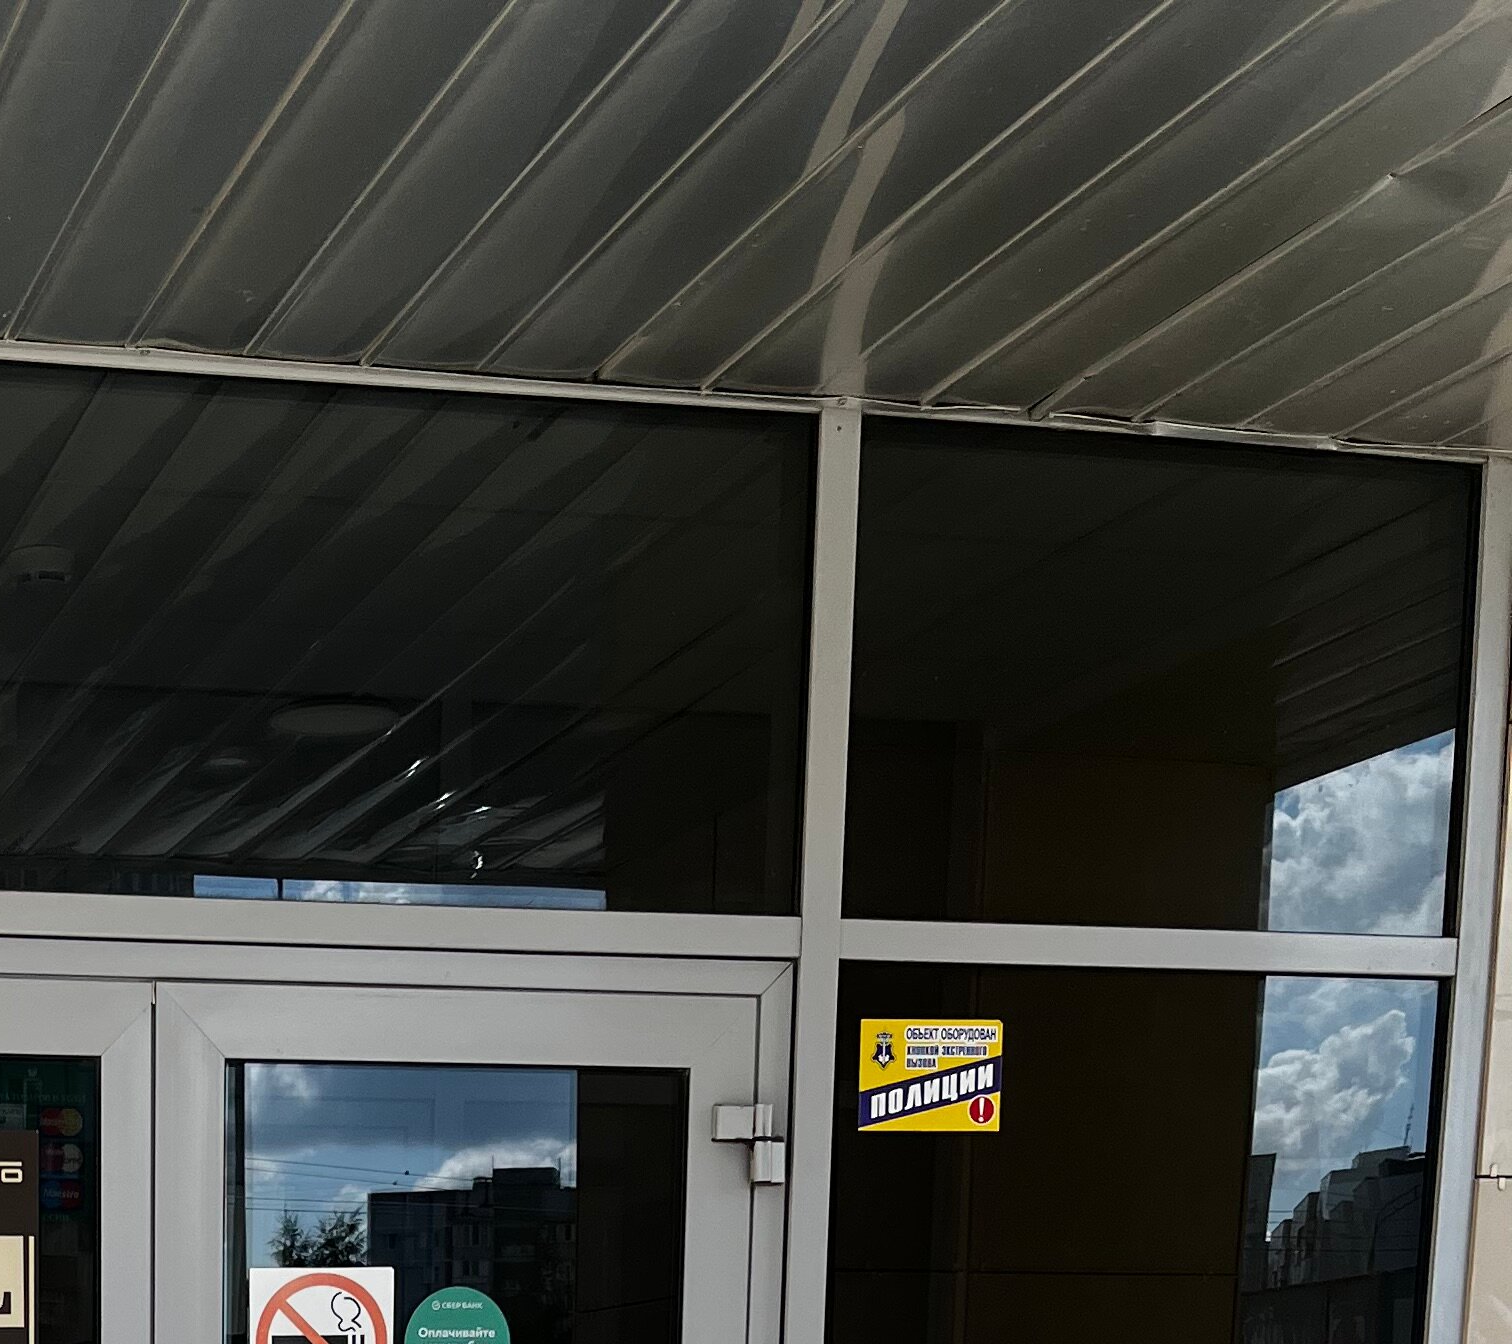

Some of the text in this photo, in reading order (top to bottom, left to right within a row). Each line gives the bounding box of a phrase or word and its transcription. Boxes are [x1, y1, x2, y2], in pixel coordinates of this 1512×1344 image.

[906, 1028, 997, 1042] ОБЪЕКТ ОБОРУДОВАН
[870, 1063, 995, 1119] ПОЛИЦИИ
[418, 1327, 496, 1338] Оплачивайте
